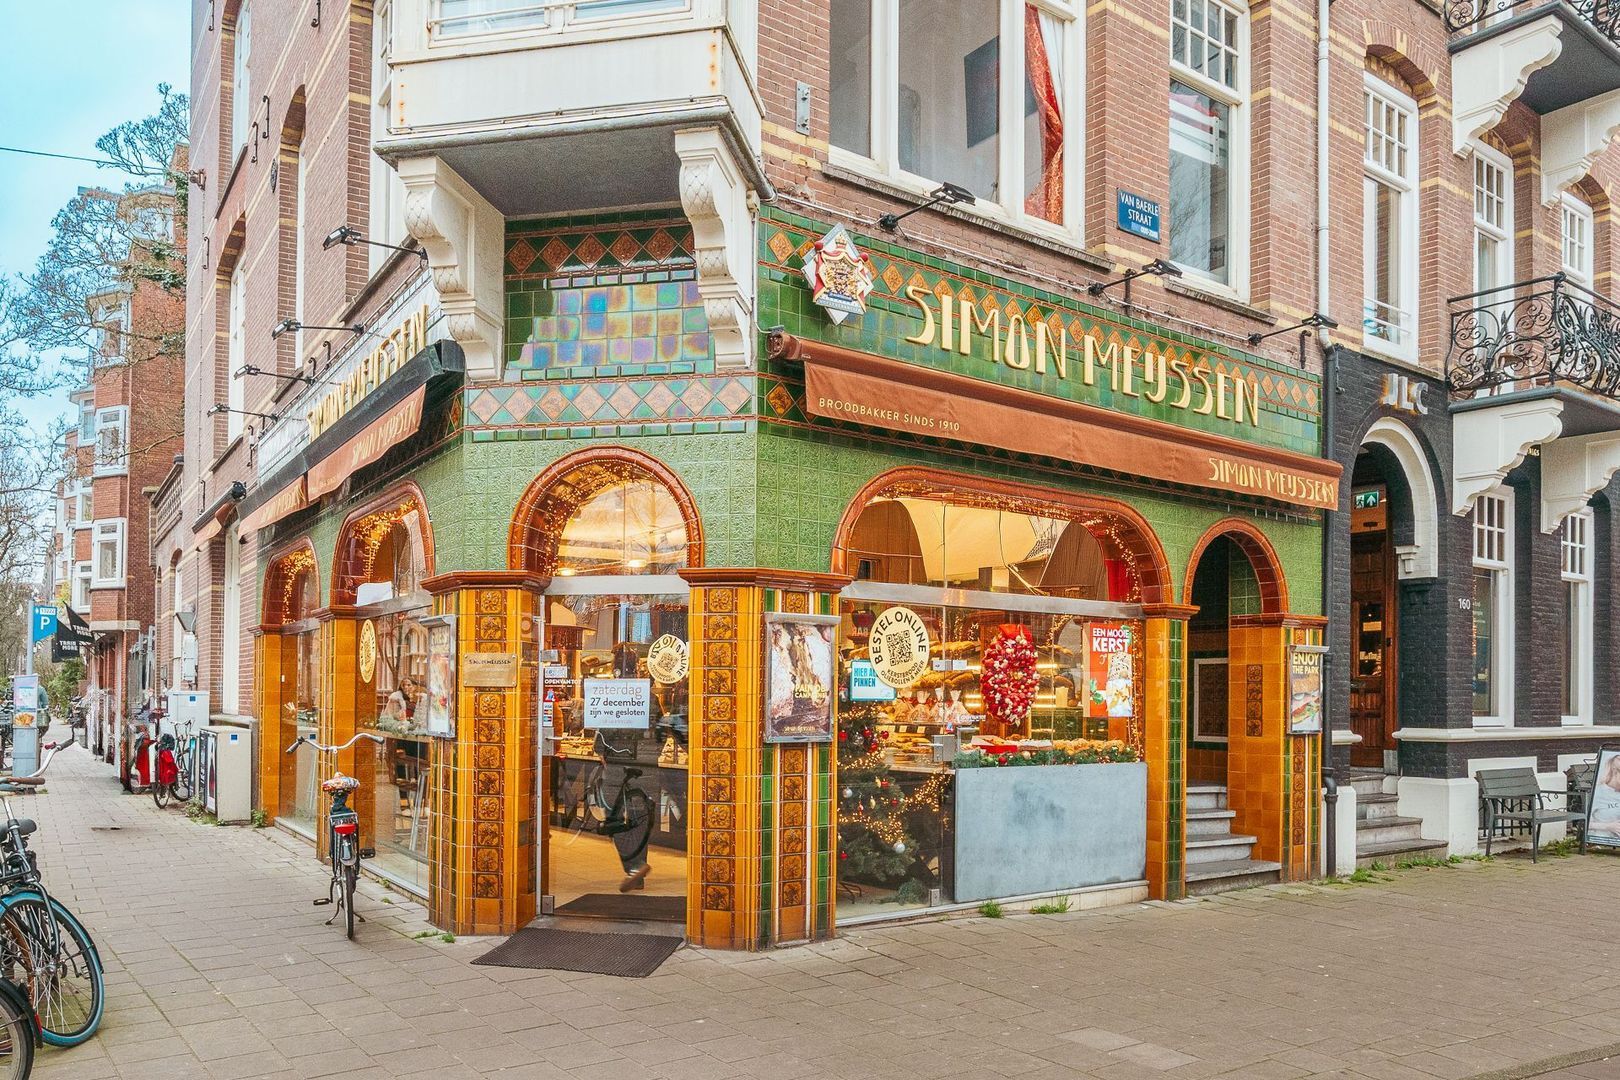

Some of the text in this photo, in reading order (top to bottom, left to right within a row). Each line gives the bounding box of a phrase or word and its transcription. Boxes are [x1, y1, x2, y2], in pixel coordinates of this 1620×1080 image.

[1120, 192, 1159, 217] VAN BAERLE
[1128, 208, 1153, 227] STRAAT
[905, 285, 1066, 379] SIMON
[819, 397, 960, 431] BROODBAKKER SINDS 1910
[1208, 457, 1263, 489] SIMON
[1458, 598, 1471, 610] 160
[40, 616, 51, 630] P
[872, 611, 927, 665] BESTEL ONLINE
[1092, 627, 1130, 639] EEN MOOIE
[1092, 637, 1130, 653] KERST
[1293, 653, 1320, 666] ENJOY
[853, 667, 868, 677] HIER
[1292, 665, 1320, 675] THE PARK
[853, 677, 876, 687] PINNEN
[880, 670, 911, 685] OLIEBOLLEN
[592, 682, 642, 700] zaterdag
[590, 698, 646, 707] 27 december
[589, 707, 601, 719] zijn
[616, 707, 646, 719] gesloten
